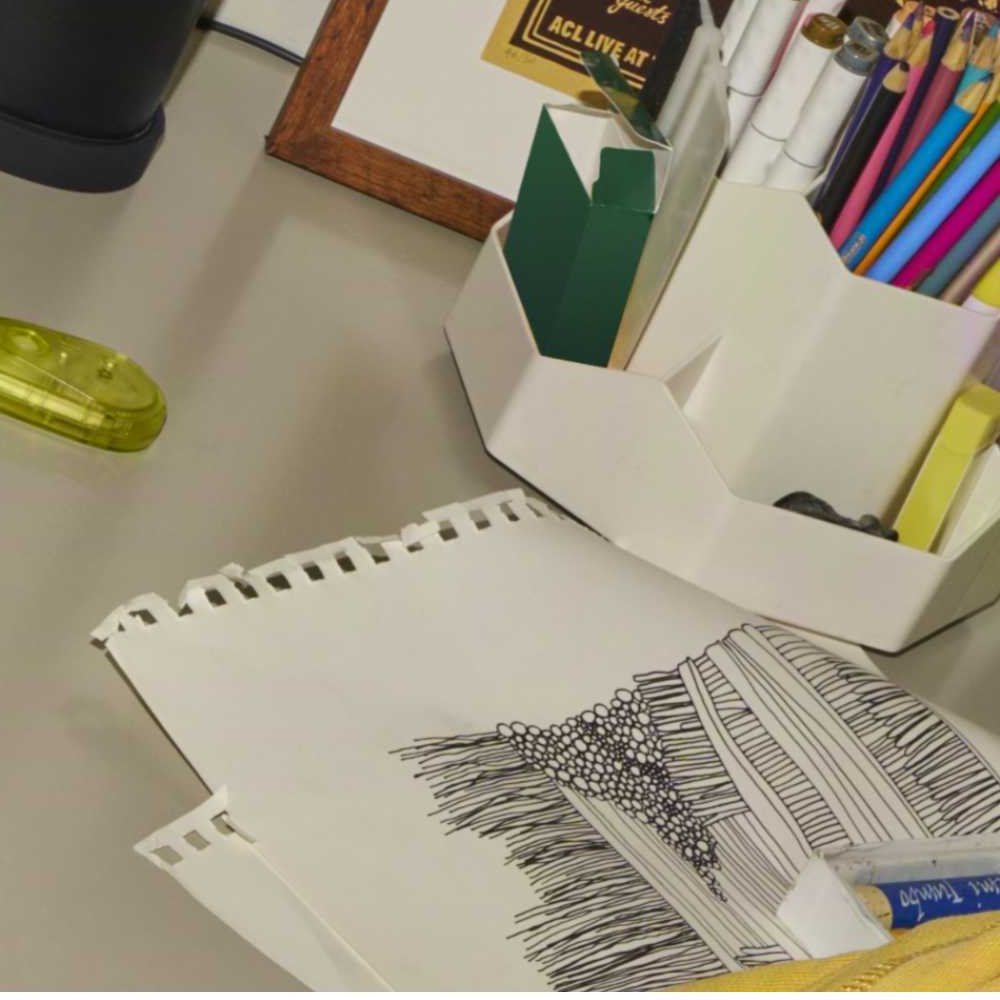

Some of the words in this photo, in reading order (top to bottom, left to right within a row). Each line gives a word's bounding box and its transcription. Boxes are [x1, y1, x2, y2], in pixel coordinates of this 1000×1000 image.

[548, 15, 584, 42] ACL
[584, 30, 625, 60] LIVE
[623, 46, 650, 68] AT
